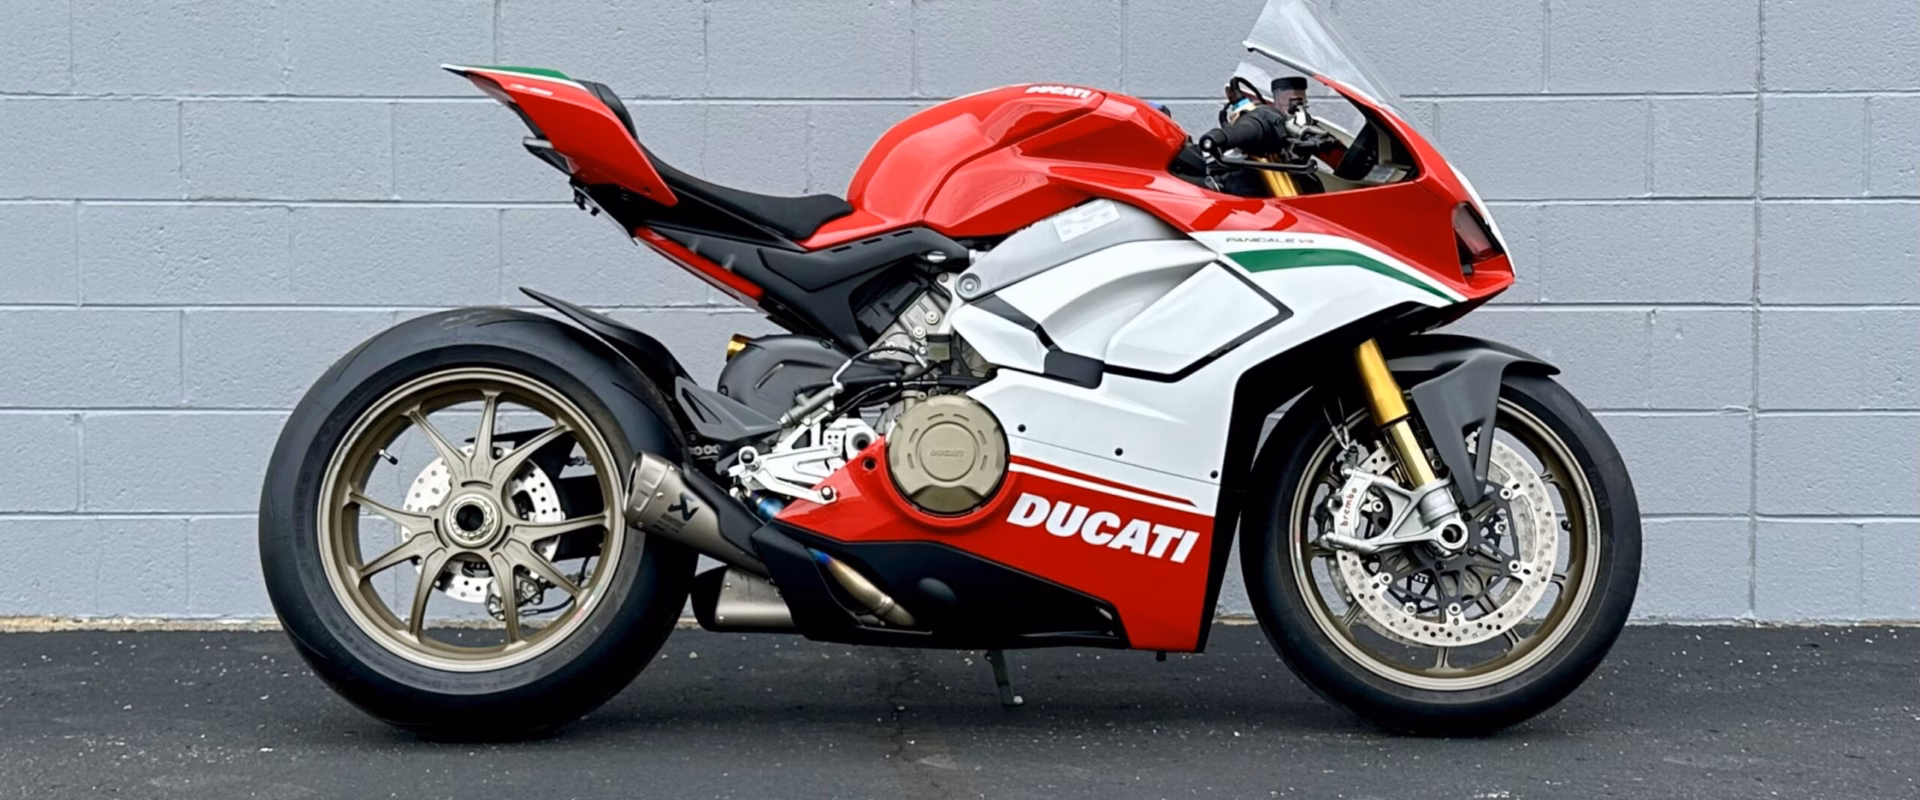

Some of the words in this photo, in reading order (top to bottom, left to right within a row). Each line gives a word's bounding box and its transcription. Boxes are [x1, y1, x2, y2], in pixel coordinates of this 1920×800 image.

[1025, 85, 1092, 98] DUCATI
[1340, 487, 1358, 527] brembo
[1006, 492, 1200, 564] DUCATI
